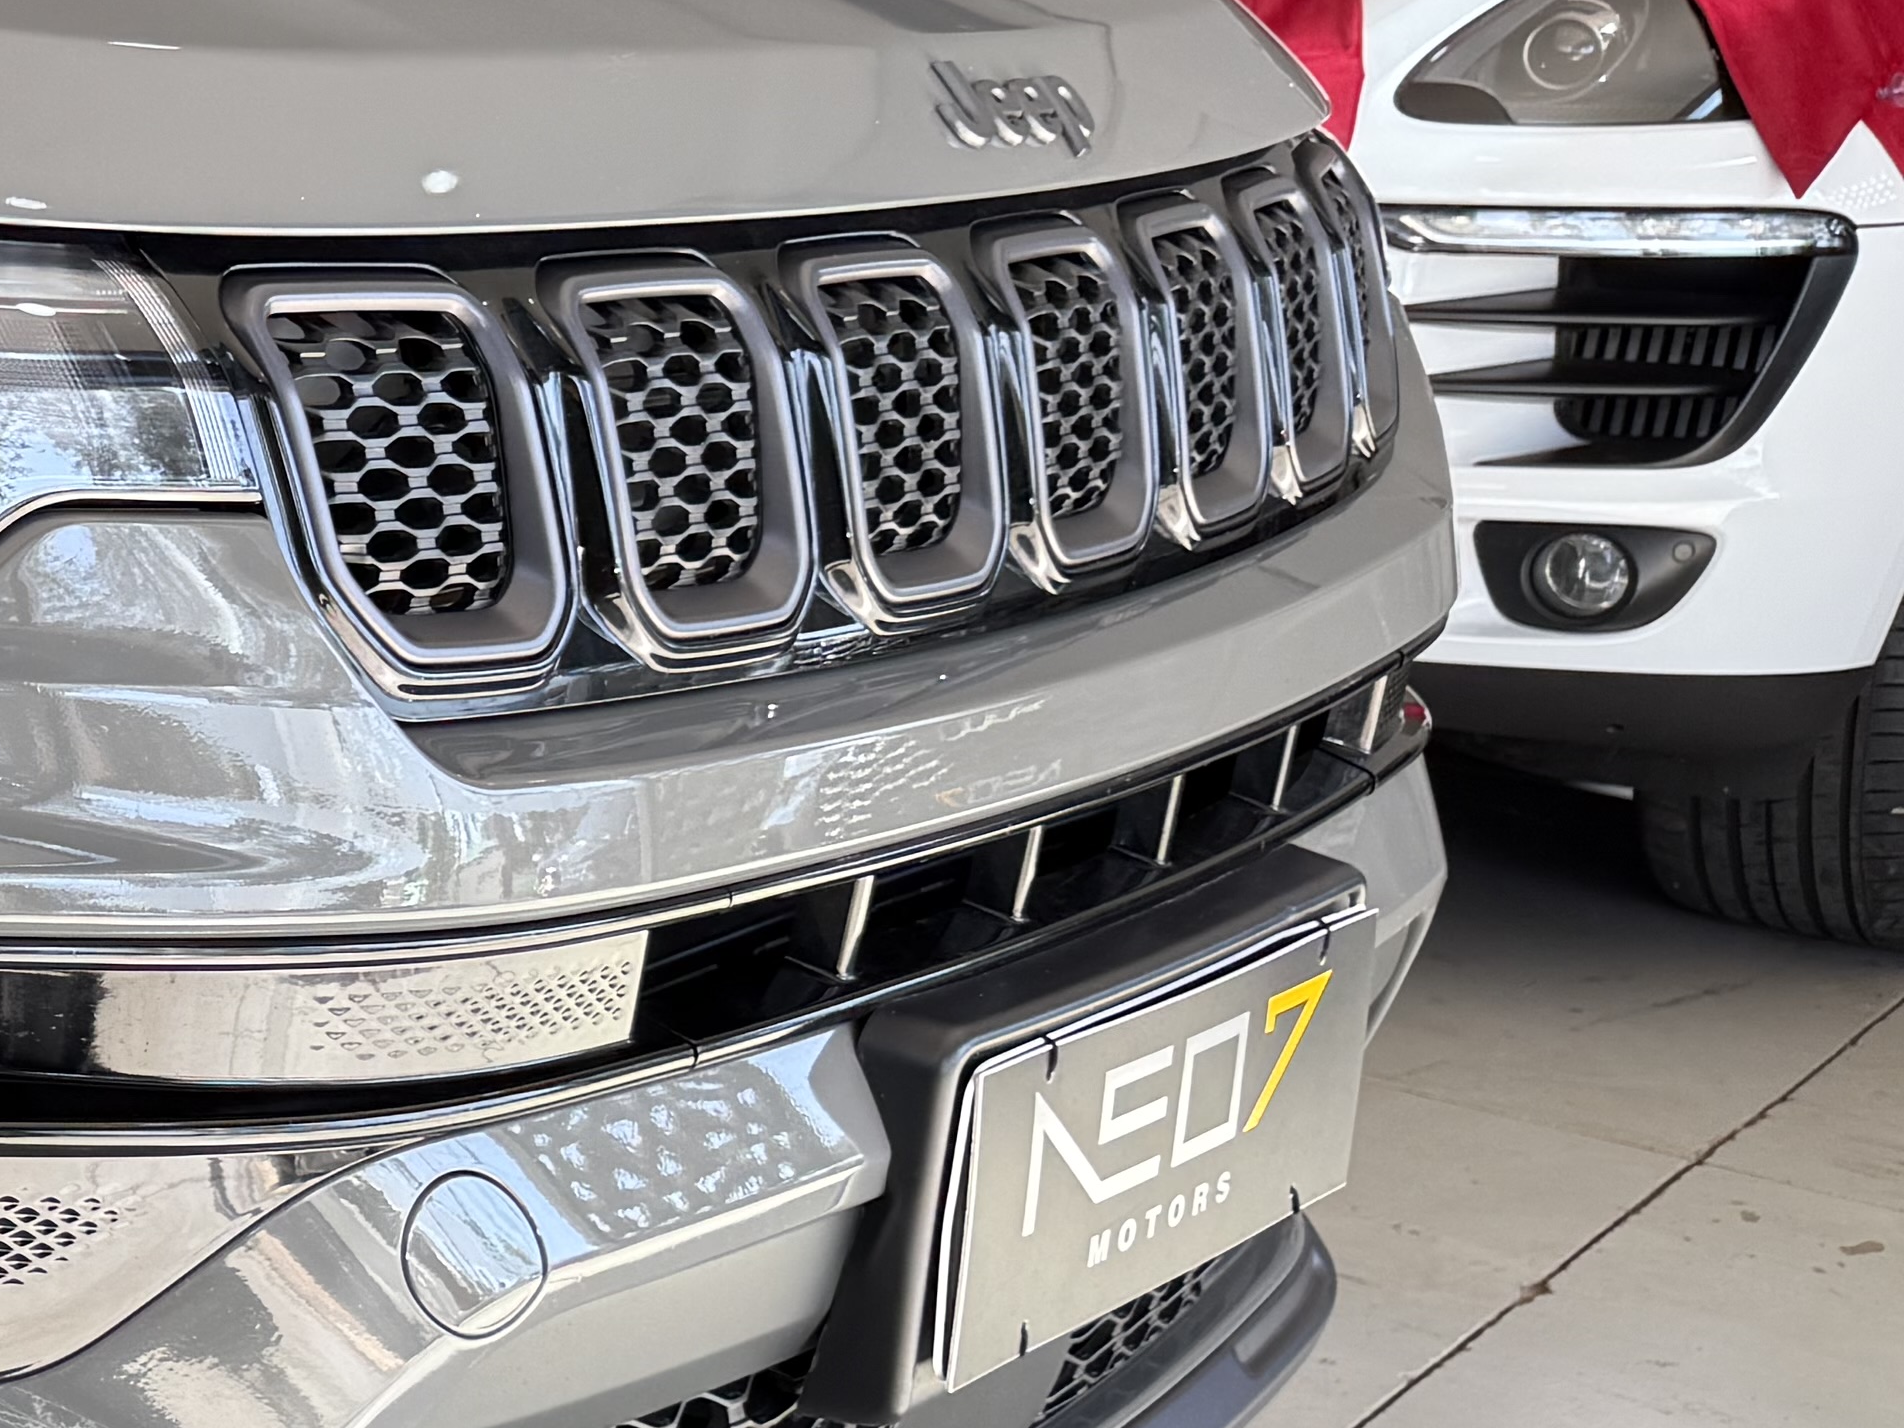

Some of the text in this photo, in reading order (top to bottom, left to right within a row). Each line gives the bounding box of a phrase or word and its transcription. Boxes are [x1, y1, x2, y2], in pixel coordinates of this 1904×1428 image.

[930, 60, 1095, 159] Jeep
[1021, 968, 1333, 1238] NEO7
[1086, 1170, 1232, 1268] MOTORS
